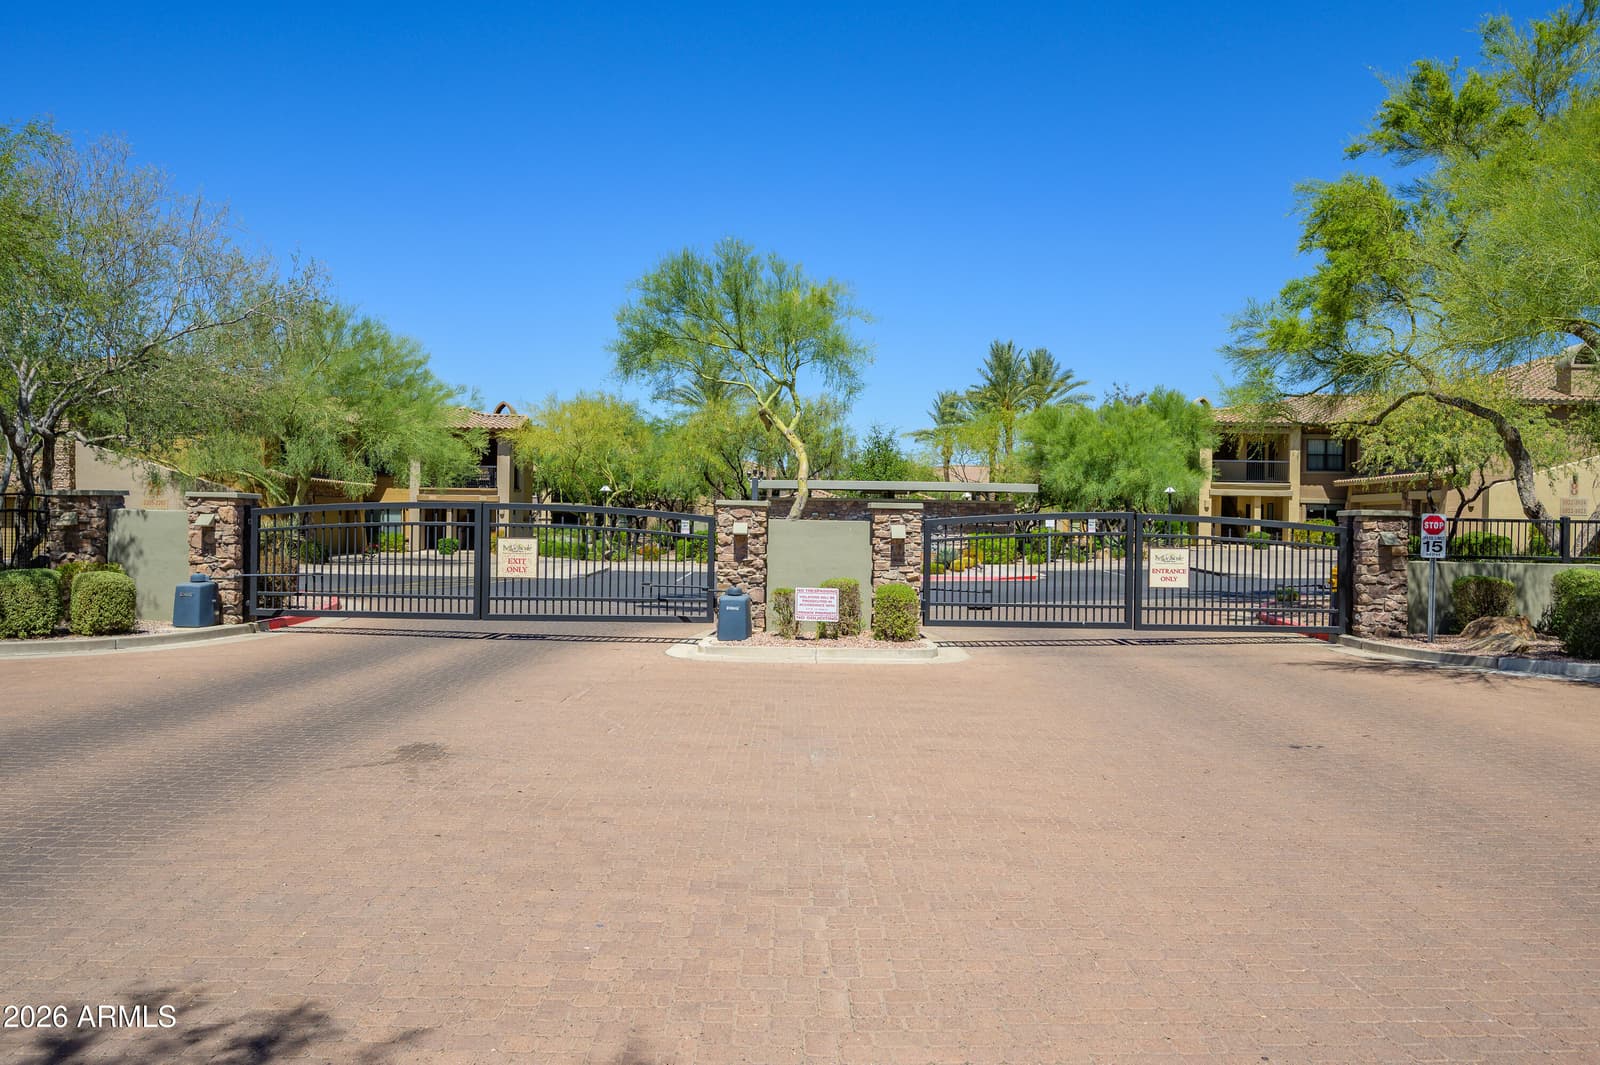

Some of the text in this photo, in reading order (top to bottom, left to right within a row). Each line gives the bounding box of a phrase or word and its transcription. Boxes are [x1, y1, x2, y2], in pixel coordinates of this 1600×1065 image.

[1423, 521, 1445, 529] STOP
[1422, 540, 1443, 552] 15
[507, 557, 527, 565] EXIT
